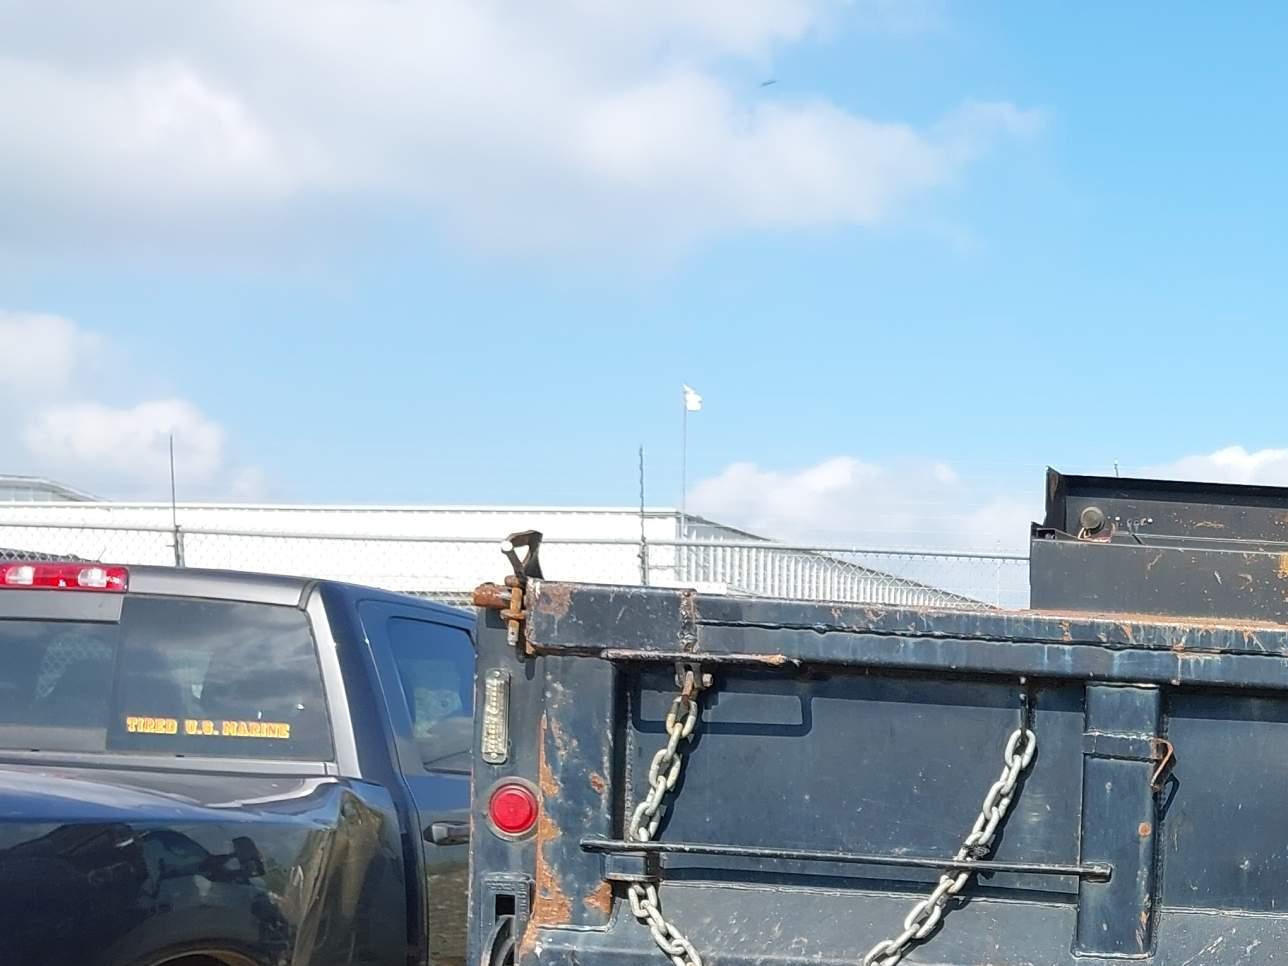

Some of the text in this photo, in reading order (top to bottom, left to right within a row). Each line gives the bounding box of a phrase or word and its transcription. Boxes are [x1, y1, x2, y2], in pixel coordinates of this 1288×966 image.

[126, 716, 290, 739] TIRED U.S. MARINE
